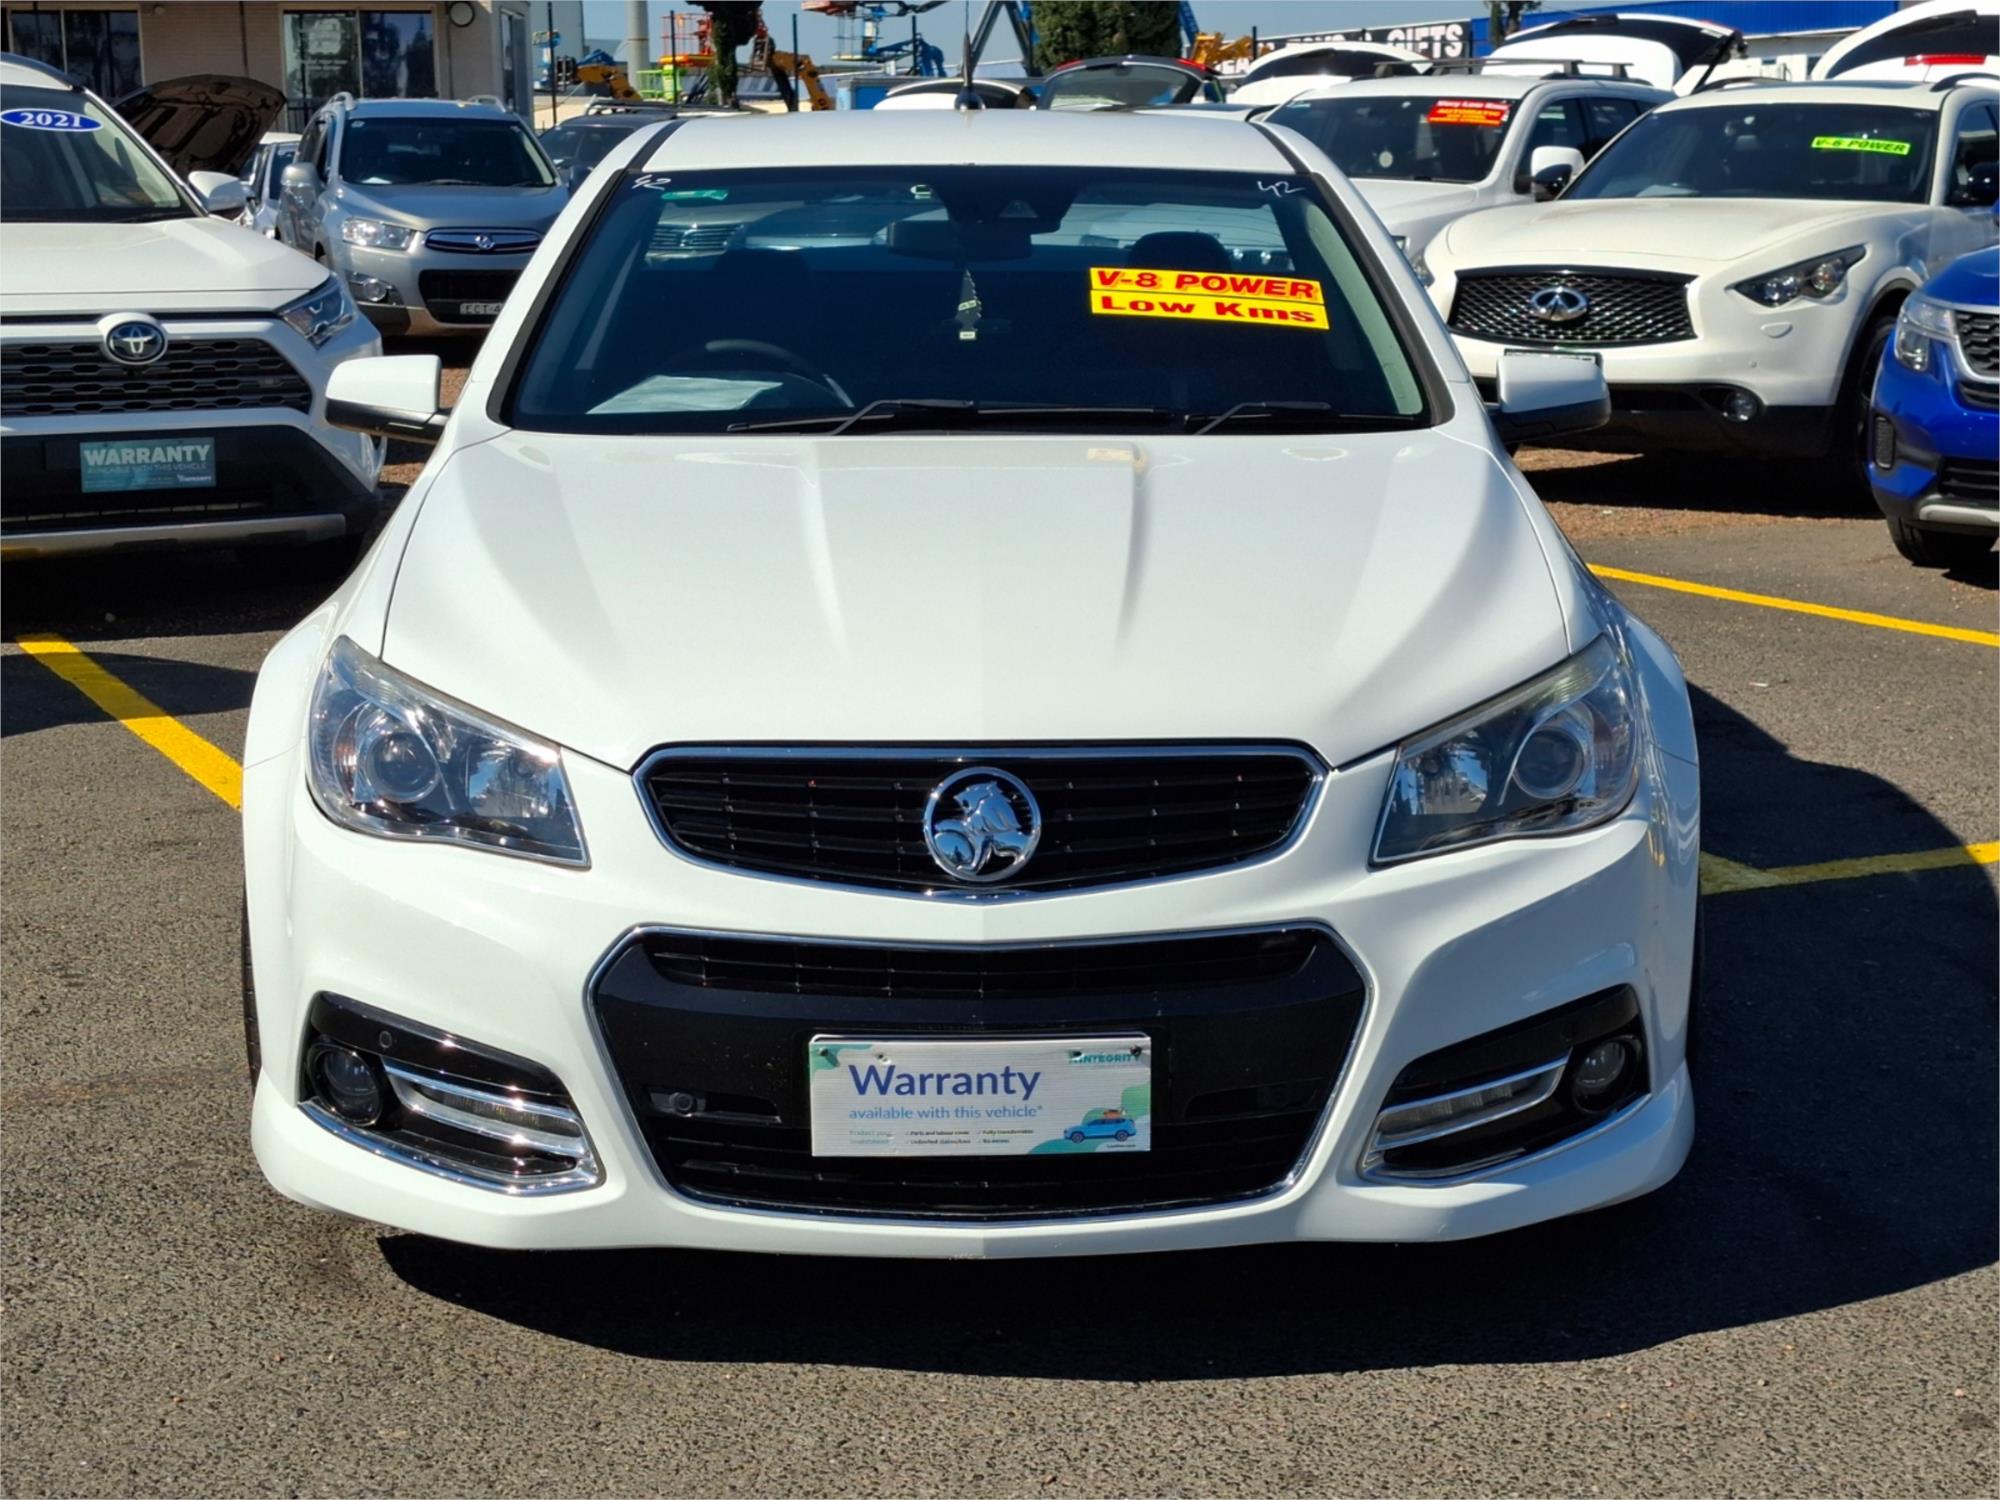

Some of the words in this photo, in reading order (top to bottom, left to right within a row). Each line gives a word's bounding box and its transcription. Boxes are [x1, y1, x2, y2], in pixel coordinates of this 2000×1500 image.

[1387, 24, 1463, 59] GIFTS
[19, 112, 82, 128] 2021
[1847, 140, 1906, 152] POWER
[1256, 181, 1306, 198] 42
[1098, 270, 1157, 288] V-8
[1175, 274, 1315, 298] POWER
[1101, 296, 1195, 313] Low
[1214, 302, 1316, 322] Kms
[83, 444, 210, 466] WARRANTY
[849, 1065, 1041, 1100] Warranty
[849, 1107, 913, 1119] available
[917, 1107, 949, 1119] with
[955, 1106, 982, 1118] this
